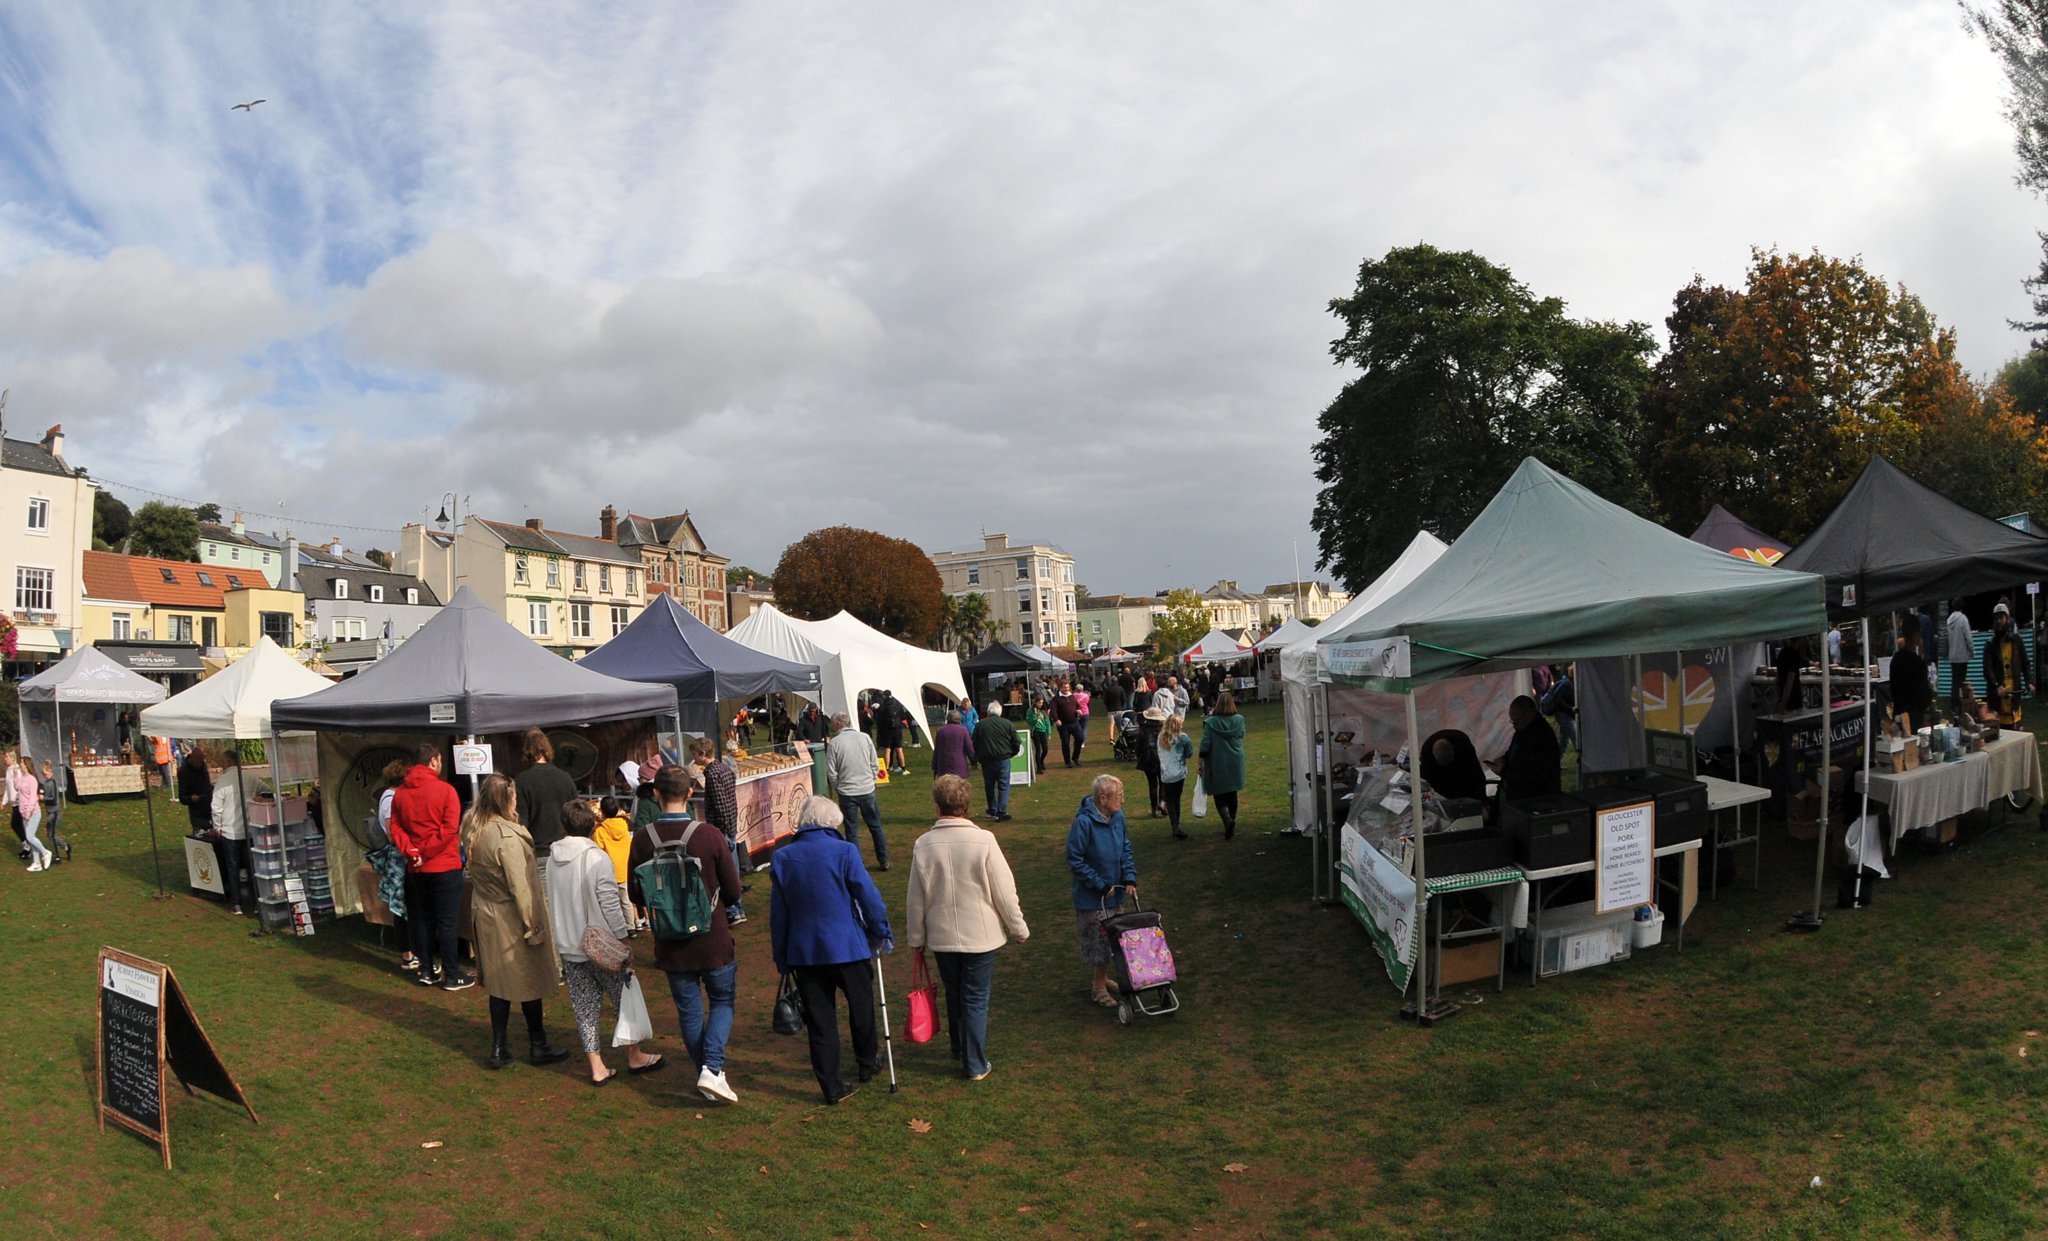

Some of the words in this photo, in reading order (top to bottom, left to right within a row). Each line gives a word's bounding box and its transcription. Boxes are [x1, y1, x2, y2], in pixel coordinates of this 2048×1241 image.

[1607, 809, 1643, 822] GLOUCESTER
[1610, 824, 1624, 833] OLD
[1624, 820, 1640, 831] SPOT
[1617, 833, 1634, 842] PORK
[1627, 842, 1639, 850] BRED
[1624, 850, 1641, 859] REARED
[1605, 862, 1619, 870] HOME
[1619, 857, 1645, 868] BUTCHERED
[117, 964, 134, 977] ROBERT
[135, 970, 156, 984] HAWKER
[125, 984, 146, 1000] VENISON
